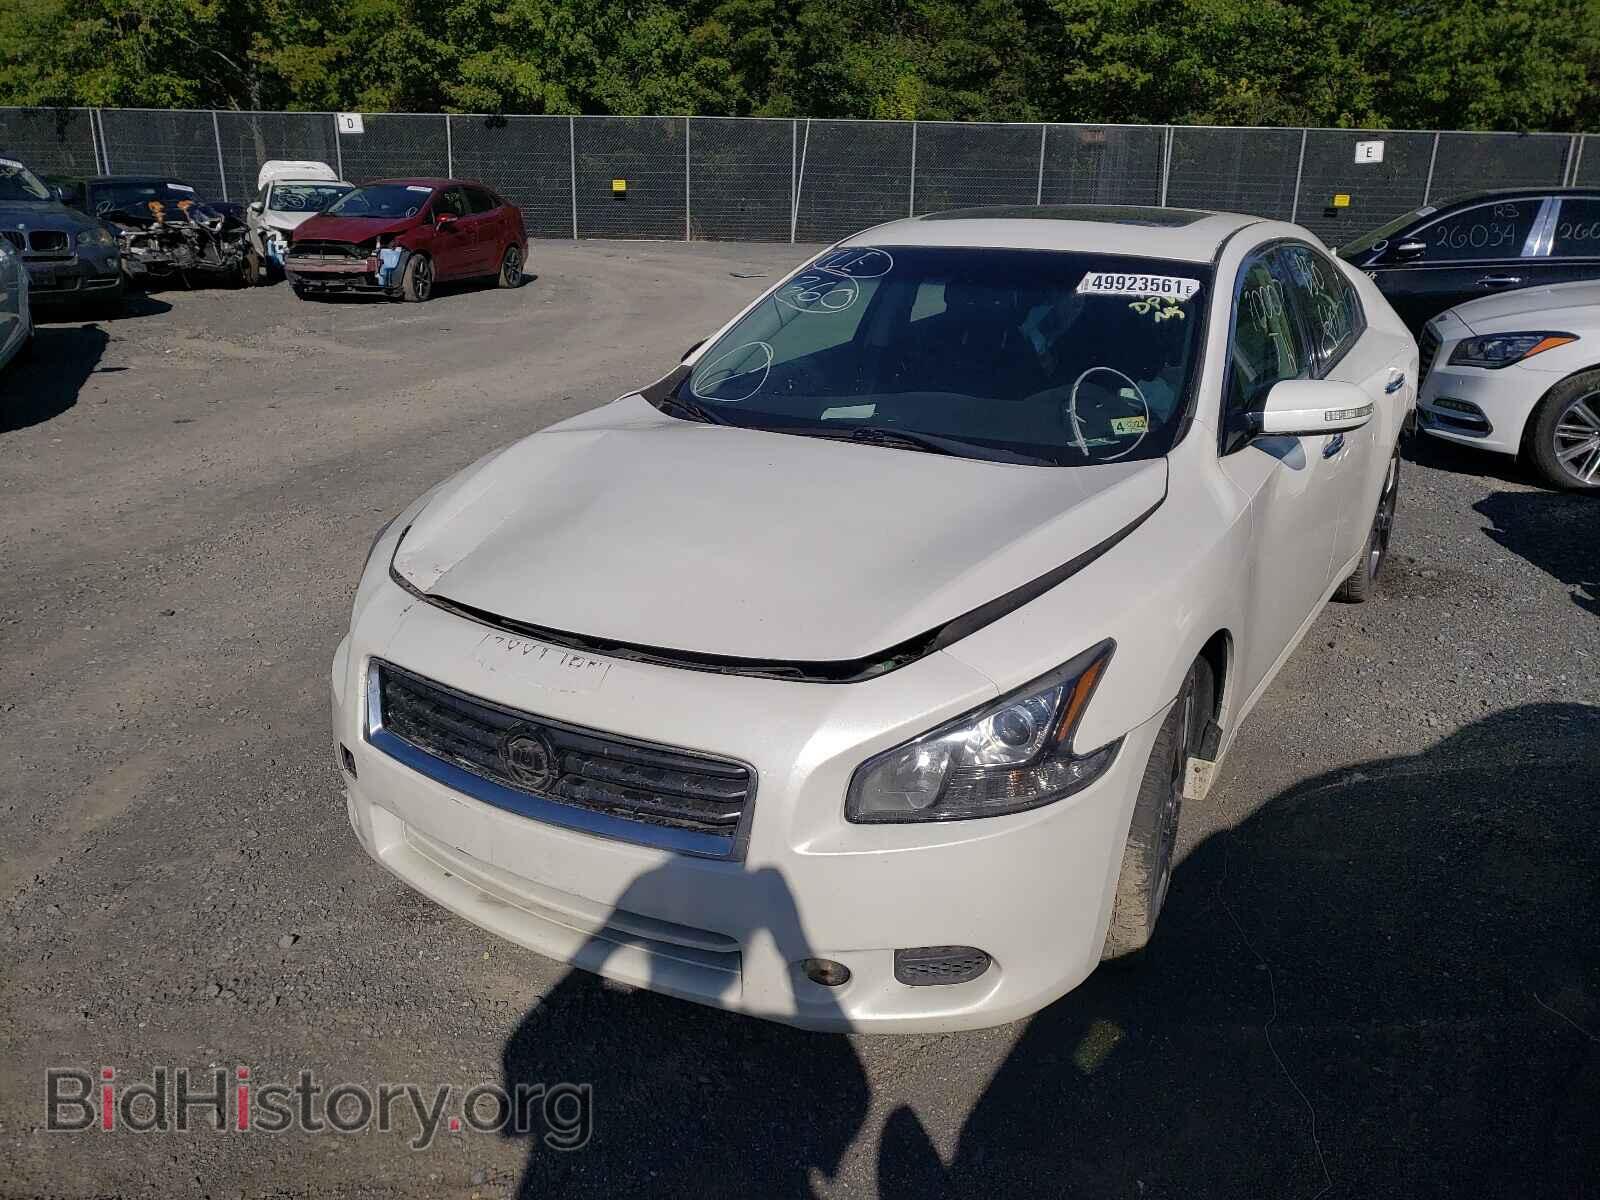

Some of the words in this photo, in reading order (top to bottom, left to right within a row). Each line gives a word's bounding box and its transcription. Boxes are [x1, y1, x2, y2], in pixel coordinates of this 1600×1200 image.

[347, 118, 354, 129] D
[1366, 147, 1373, 158] E
[1436, 222, 1515, 249] 26034
[1092, 275, 1182, 294] 49923561
[1186, 285, 1193, 294] E
